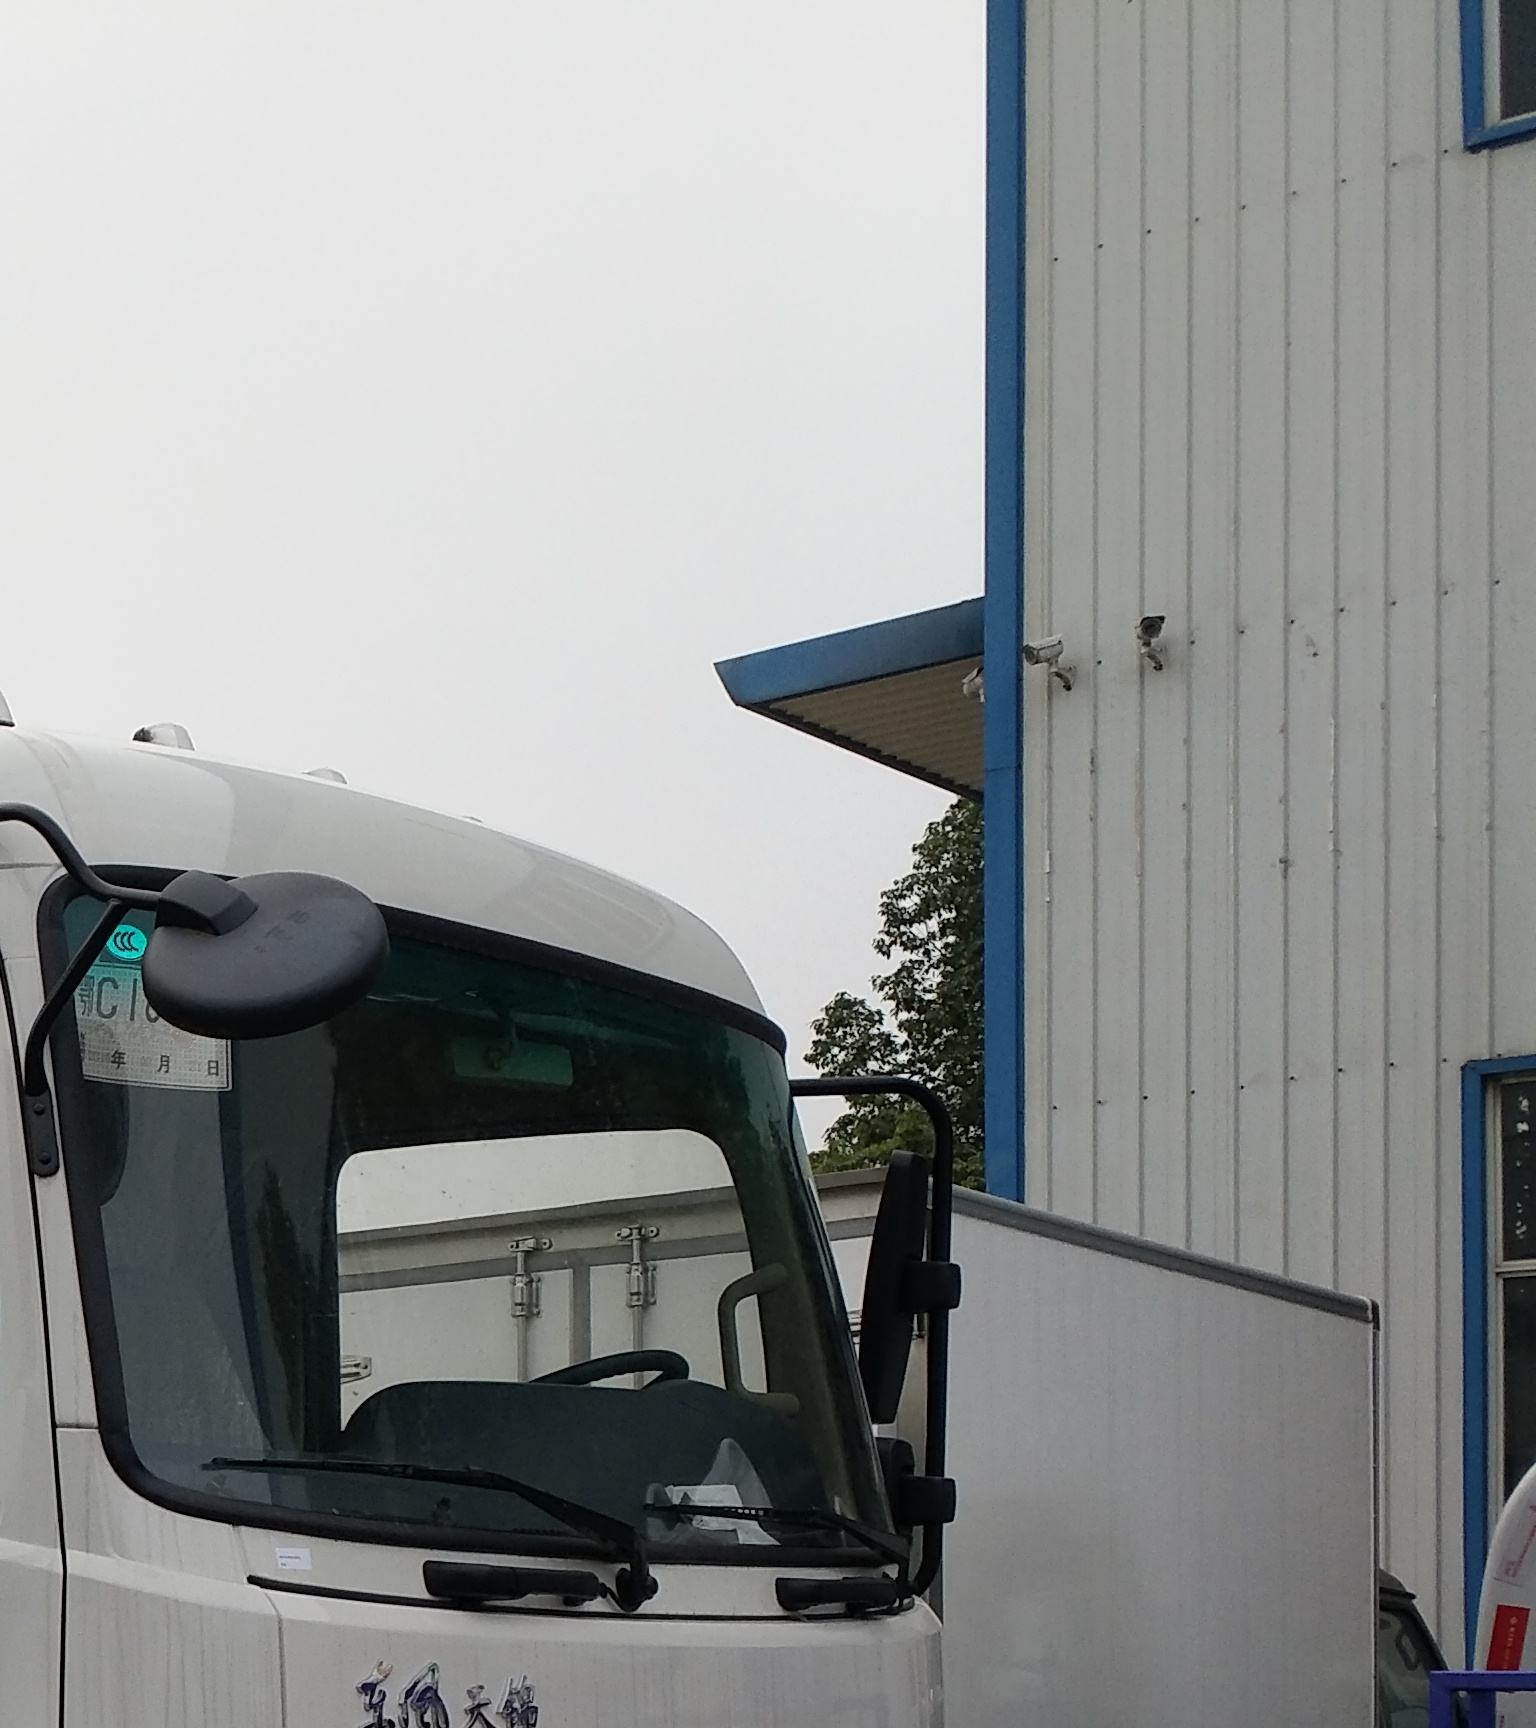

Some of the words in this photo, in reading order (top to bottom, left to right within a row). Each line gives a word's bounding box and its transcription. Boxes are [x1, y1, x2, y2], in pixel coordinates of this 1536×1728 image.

[110, 1049, 127, 1070] 年
[157, 1054, 171, 1074] 月
[207, 1059, 220, 1077] 日
